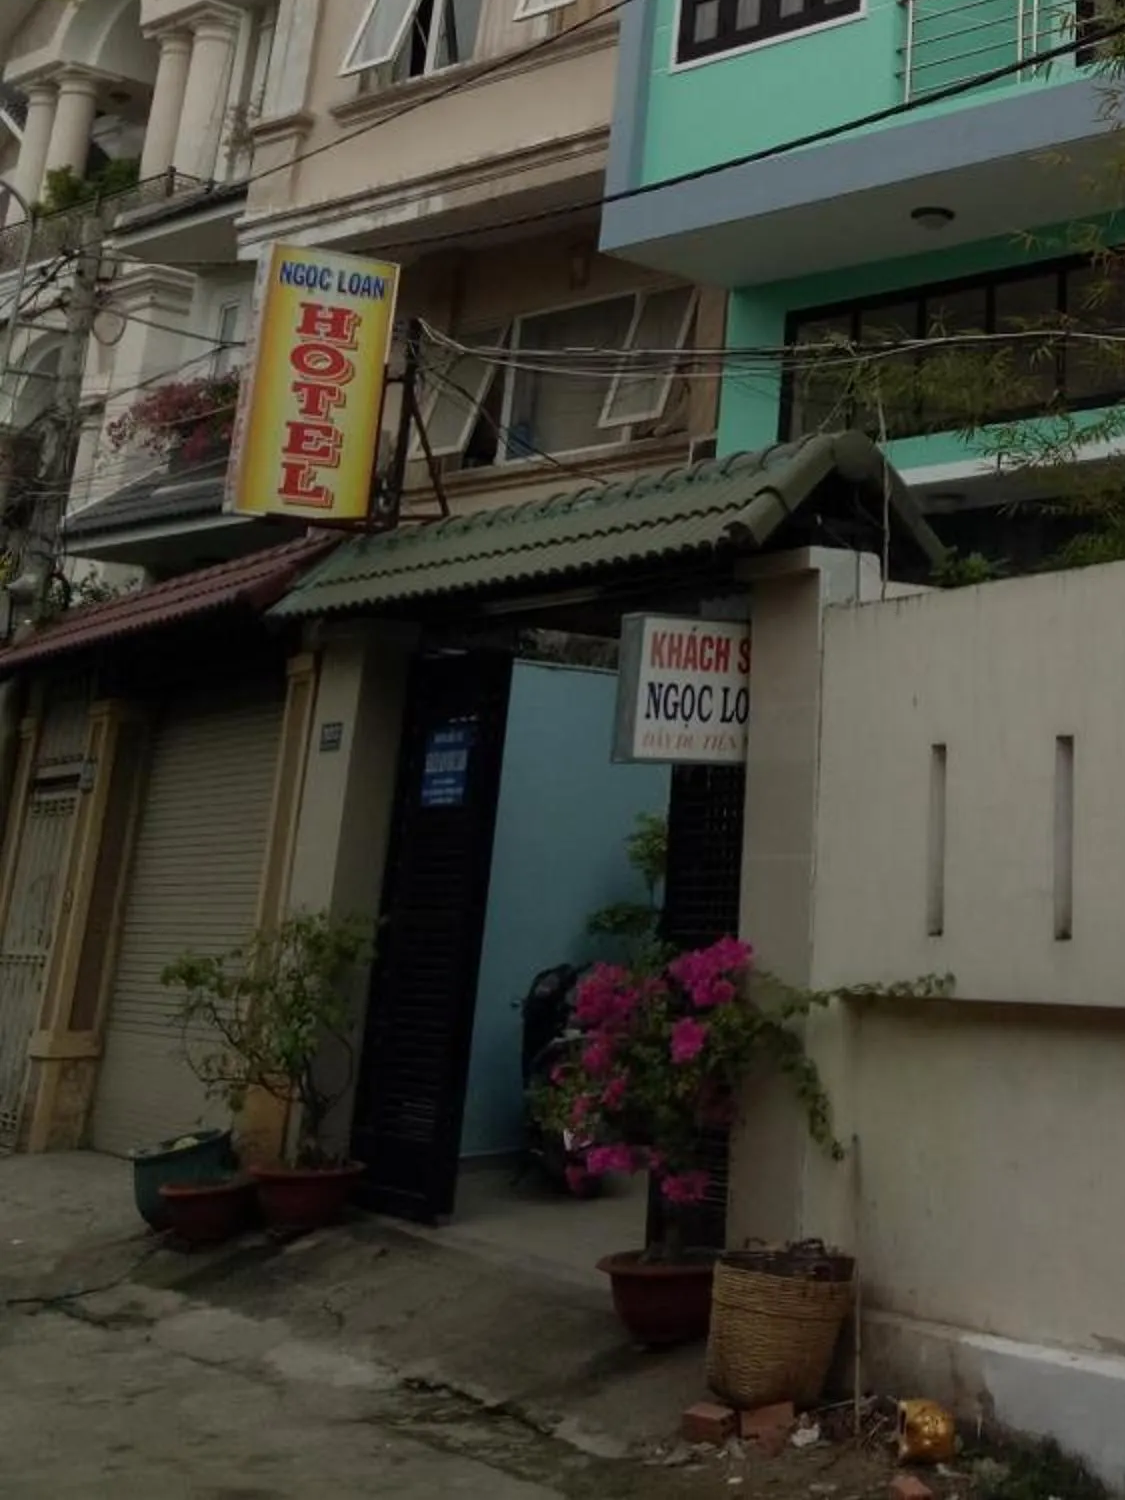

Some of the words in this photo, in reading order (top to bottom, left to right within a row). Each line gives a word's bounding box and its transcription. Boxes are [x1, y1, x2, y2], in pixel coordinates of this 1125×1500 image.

[279, 260, 332, 293] NGỌC
[337, 270, 386, 298] LOAN
[277, 301, 362, 510] HOTEL
[651, 625, 731, 673] KHÁCH
[645, 681, 713, 728] NGỌC
